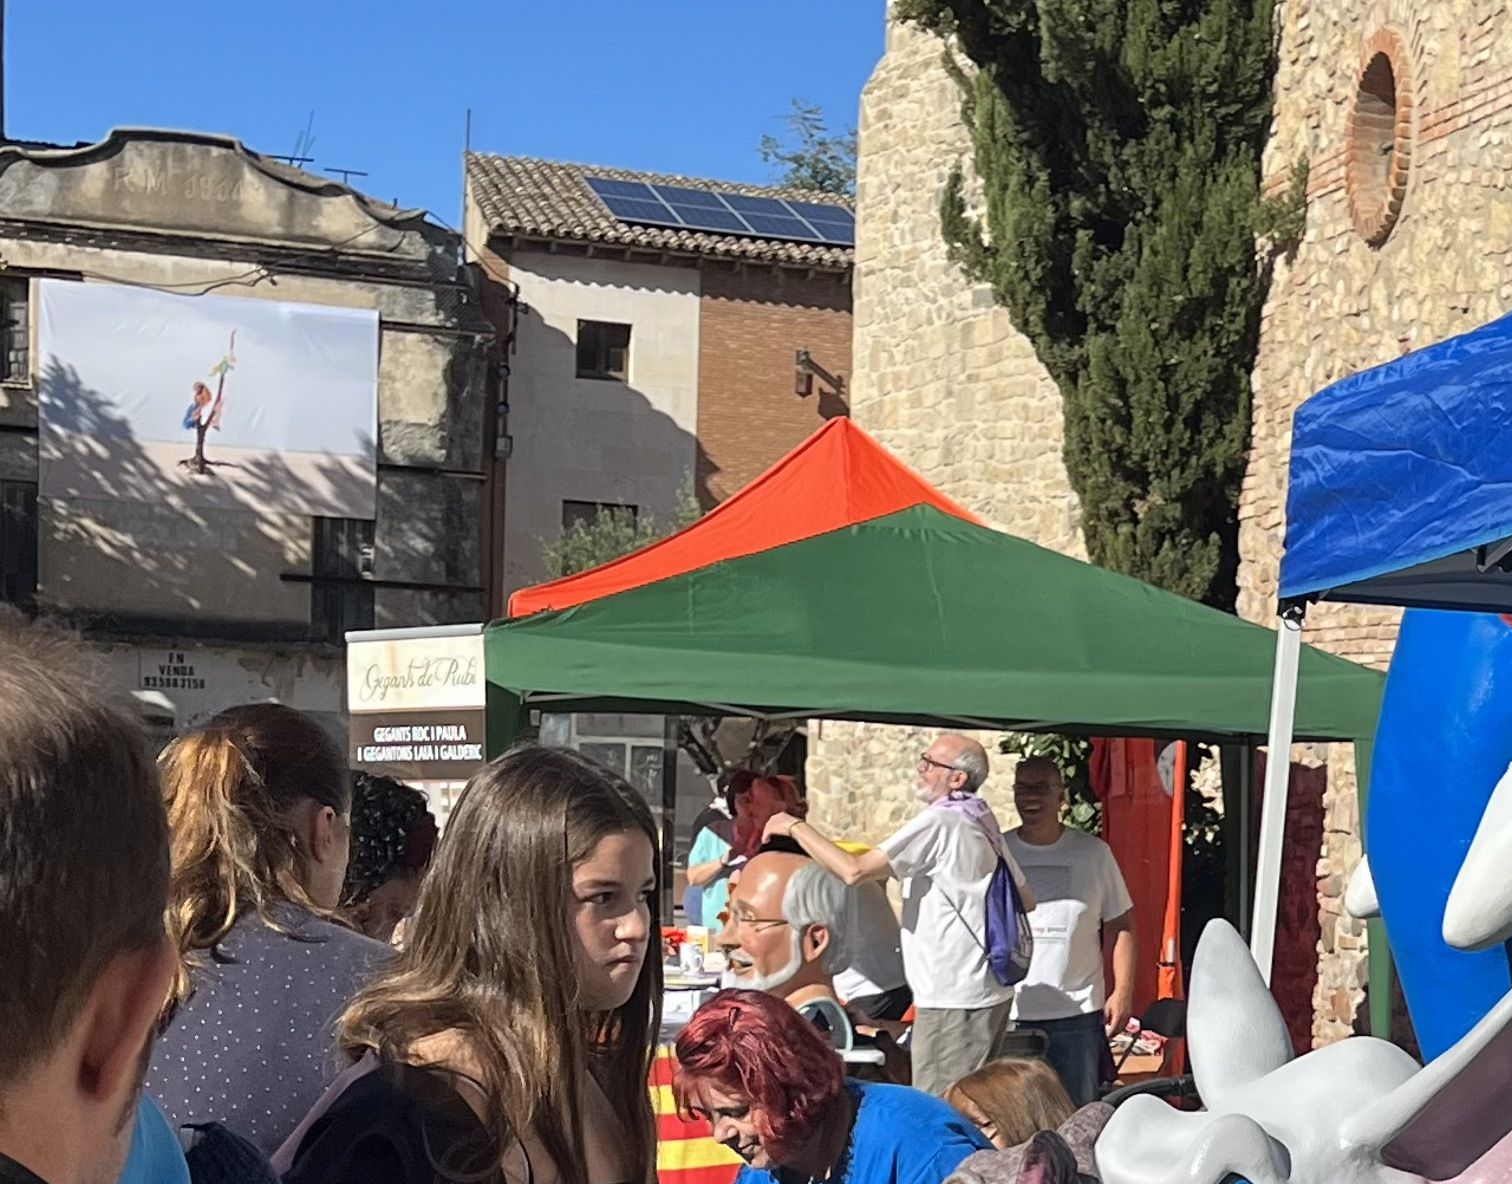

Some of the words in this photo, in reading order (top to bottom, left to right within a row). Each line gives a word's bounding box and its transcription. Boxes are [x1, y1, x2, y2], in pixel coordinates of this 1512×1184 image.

[168, 652, 184, 664] EN
[159, 664, 194, 676] VENDA
[360, 658, 414, 702] Gegants
[374, 727, 410, 742] GEGANTS
[412, 727, 431, 741] ROC
[436, 725, 467, 741] PAULA
[357, 747, 362, 761] I
[364, 746, 412, 761] GEGANTONS
